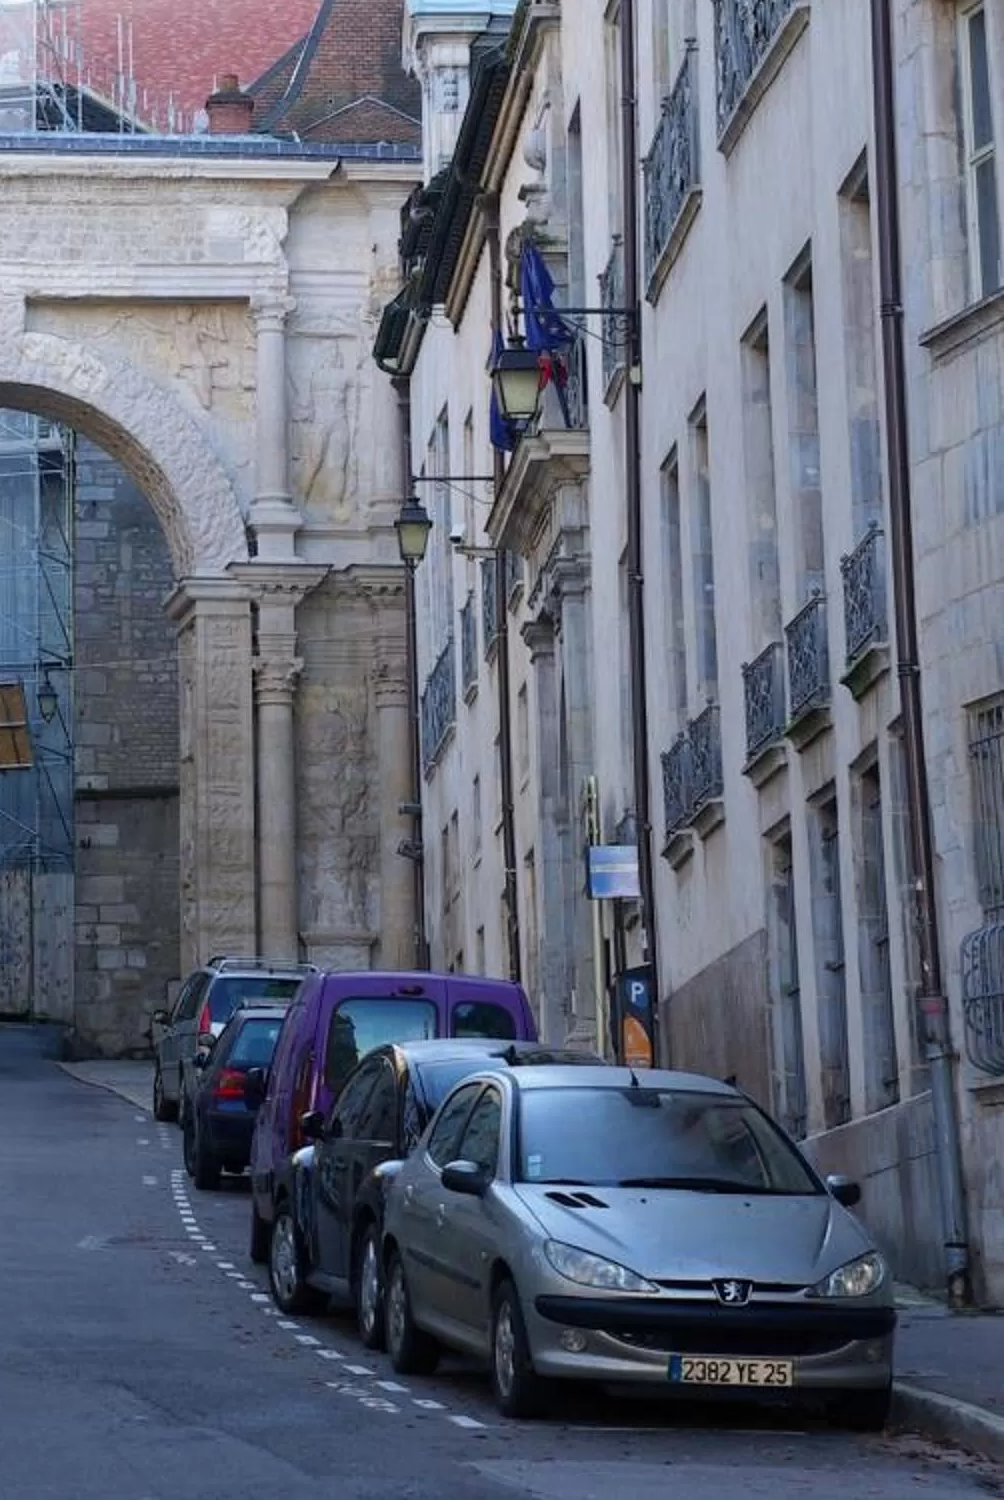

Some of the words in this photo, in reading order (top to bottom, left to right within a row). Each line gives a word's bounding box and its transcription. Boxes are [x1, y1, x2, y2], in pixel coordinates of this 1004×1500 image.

[632, 982, 644, 1002] P
[683, 1361, 730, 1382] 2382
[736, 1363, 758, 1382] YE
[763, 1364, 787, 1384] 25
